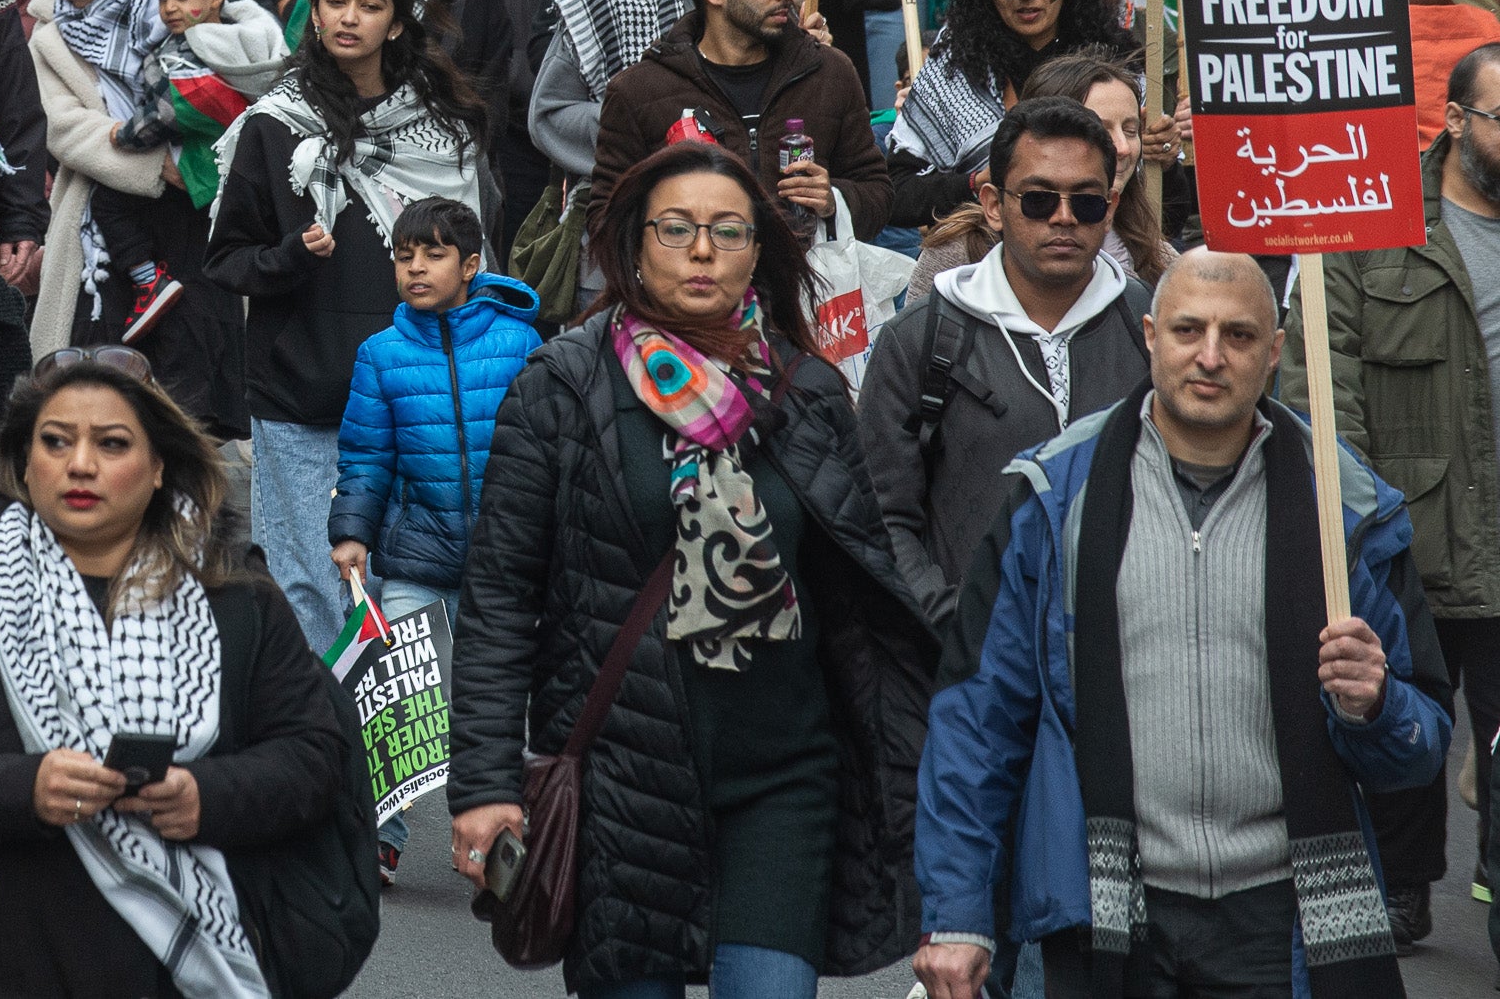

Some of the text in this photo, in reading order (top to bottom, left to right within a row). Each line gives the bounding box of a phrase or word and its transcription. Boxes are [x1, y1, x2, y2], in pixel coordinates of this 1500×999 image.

[1276, 24, 1309, 50] for
[1198, 44, 1402, 103] PALESTINE
[1236, 122, 1369, 177] الحرية
[1227, 171, 1394, 228] لفلسطين
[1264, 231, 1355, 248] socialistworker.co.uk
[378, 637, 438, 678] WILL
[389, 611, 432, 651] FR
[356, 660, 442, 727] PALESTI
[361, 685, 448, 751] THE SEA
[366, 708, 450, 778] RIVER T
